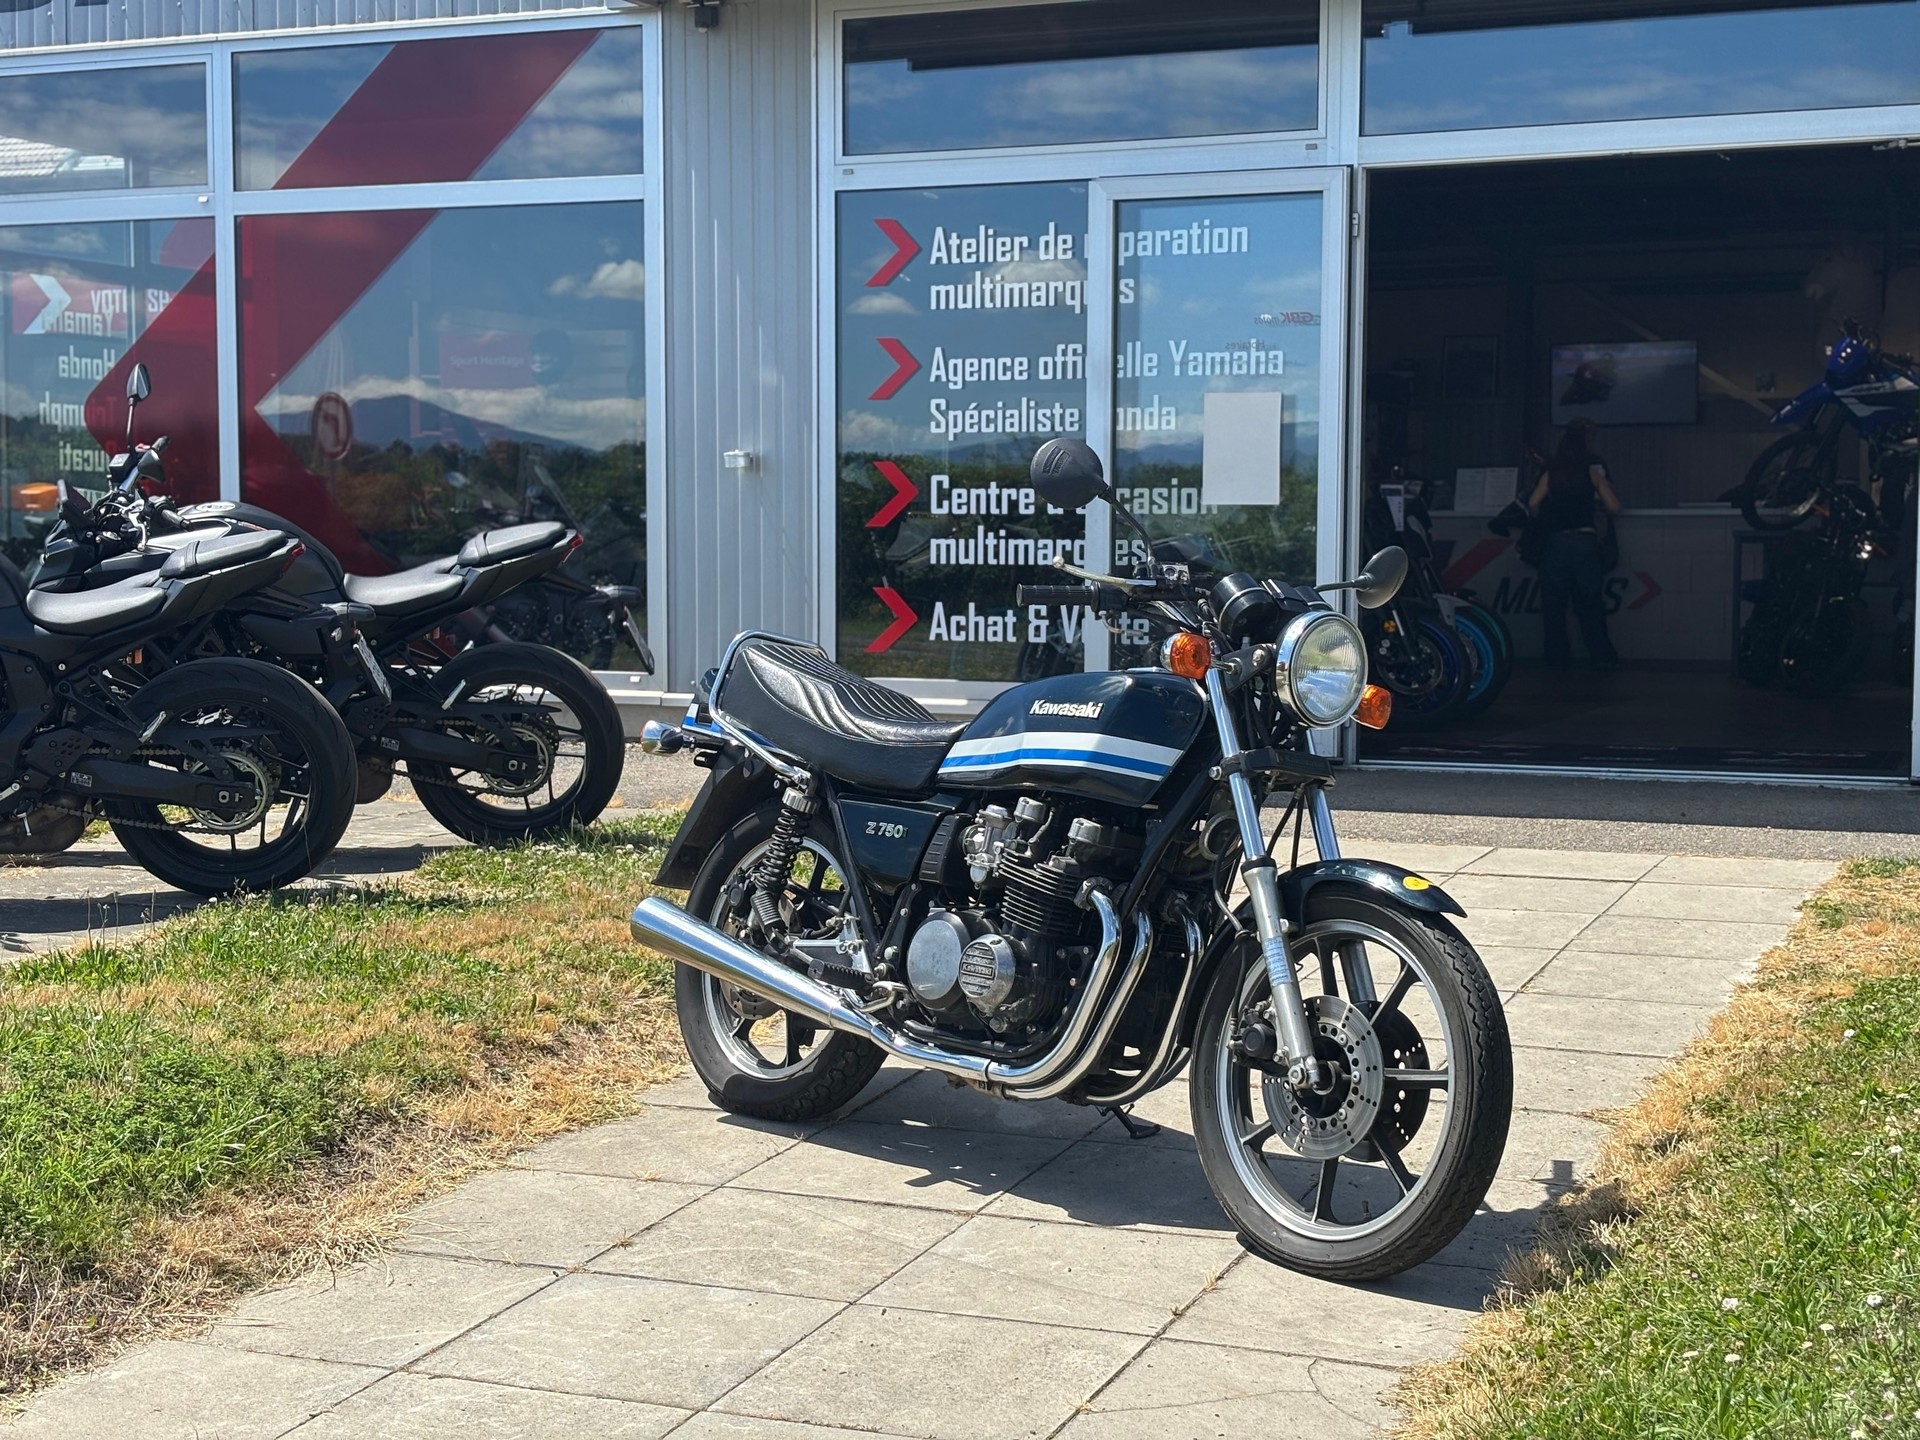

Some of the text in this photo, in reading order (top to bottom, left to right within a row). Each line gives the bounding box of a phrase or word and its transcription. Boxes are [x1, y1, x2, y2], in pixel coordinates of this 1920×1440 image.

[929, 219, 1249, 267] Atelier de paration
[929, 271, 1135, 314] multimarqs
[449, 355, 479, 367] Sport
[929, 347, 1029, 390] Agence
[1168, 339, 1285, 377] Yamaha
[929, 397, 1080, 441] Spécialiste
[930, 474, 1036, 515] Centre
[928, 601, 1150, 645] Achat & Vte
[1028, 699, 1105, 720] Kawasaki
[865, 820, 878, 835] Z
